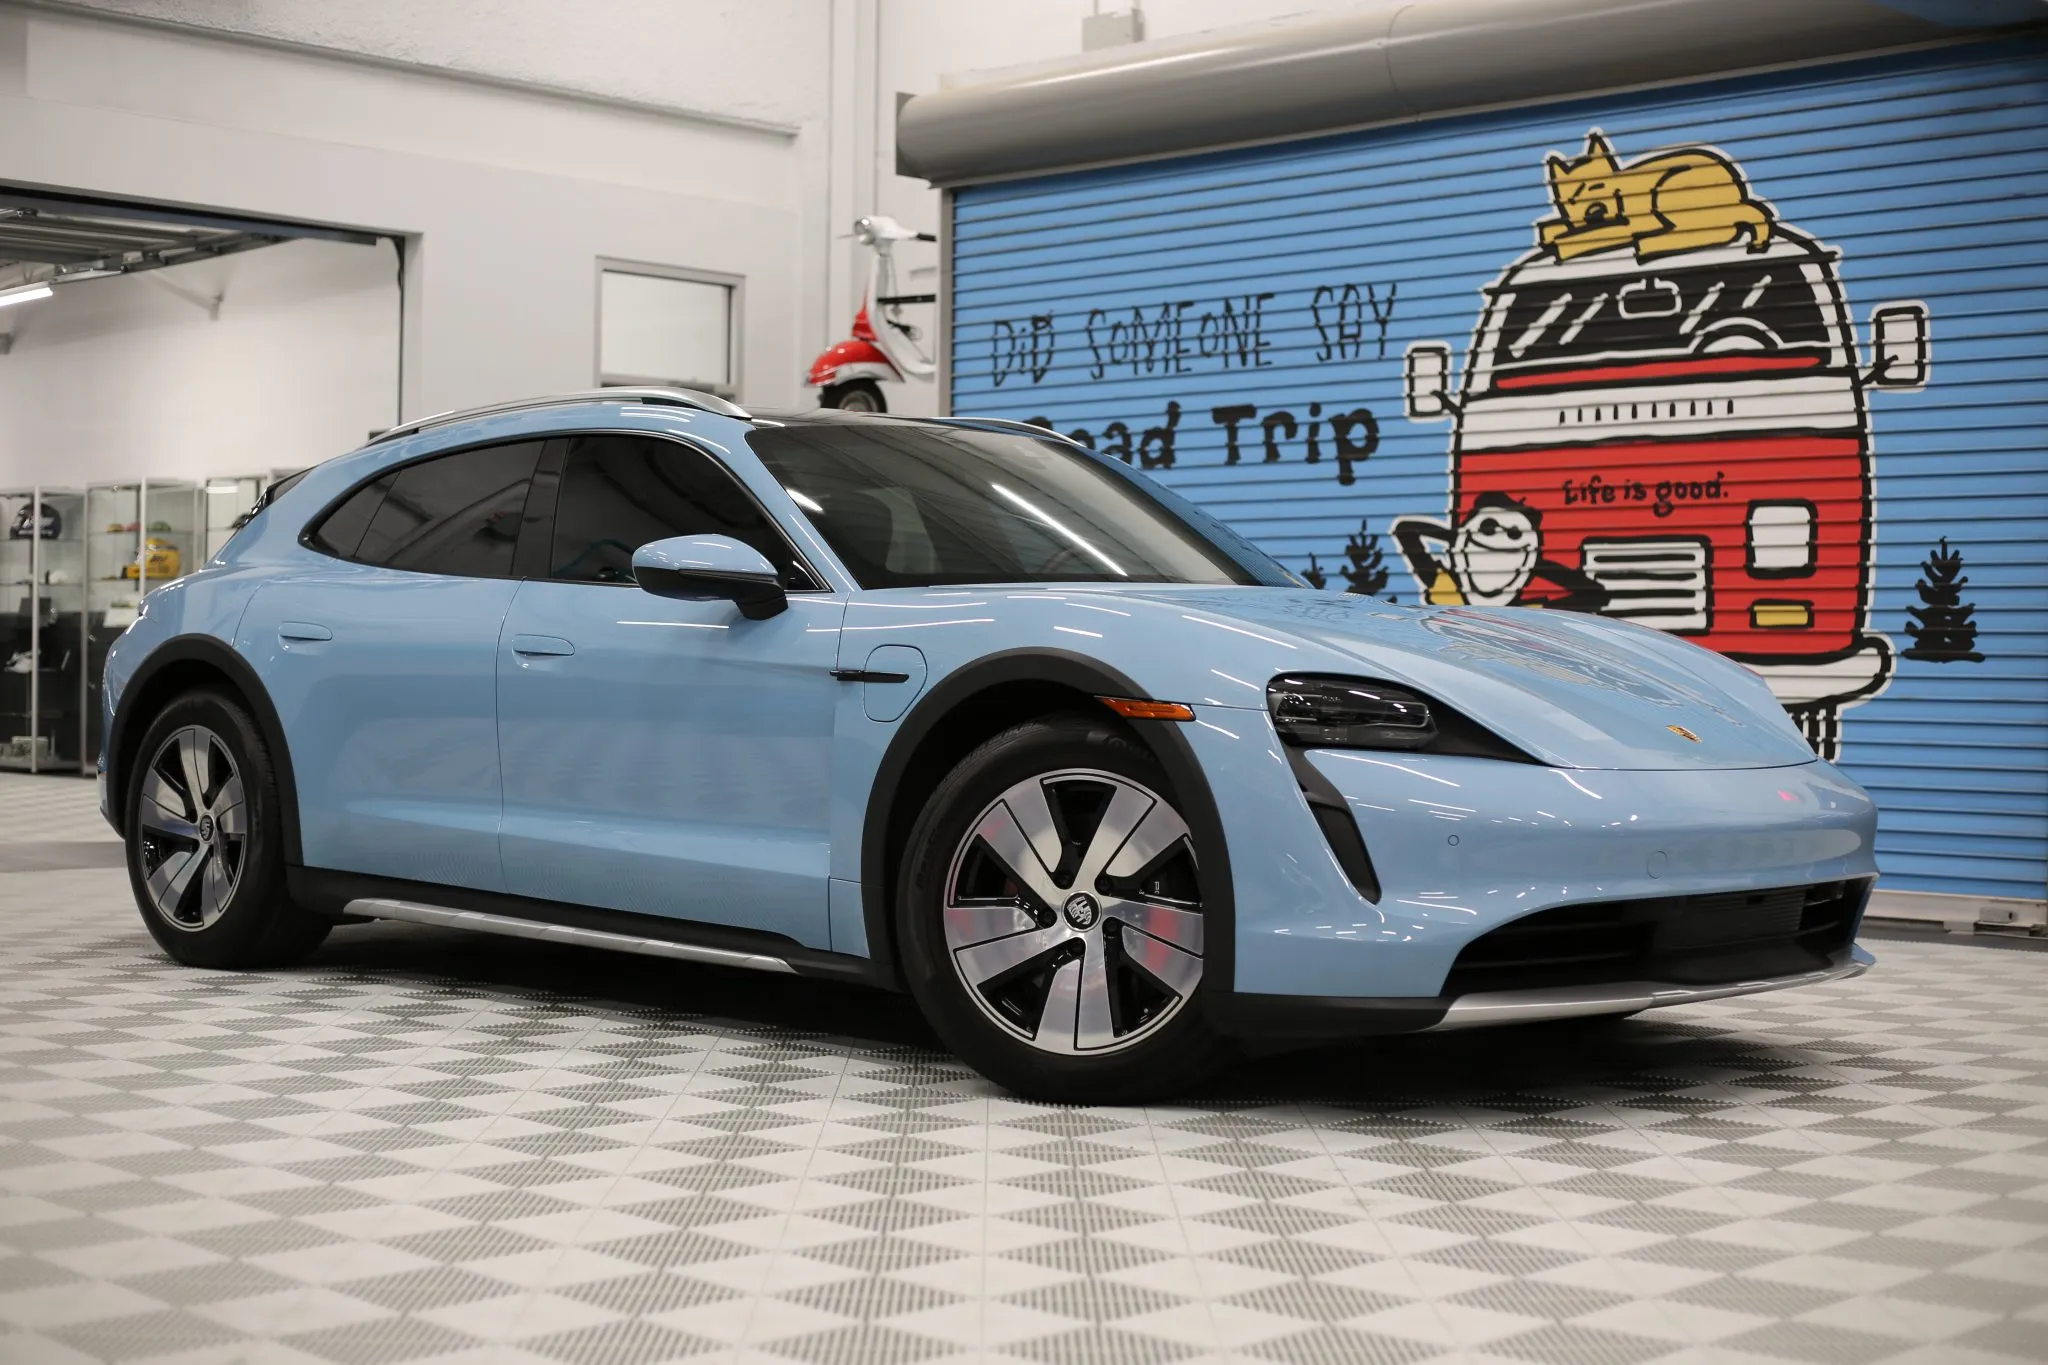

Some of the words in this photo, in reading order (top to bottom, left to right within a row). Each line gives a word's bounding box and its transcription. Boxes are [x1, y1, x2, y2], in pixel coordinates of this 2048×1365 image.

[1311, 282, 1397, 361] SAY
[1022, 400, 1182, 470] ad
[1211, 402, 1379, 486] Trip
[1562, 474, 1617, 505] Life
[1623, 479, 1647, 500] is
